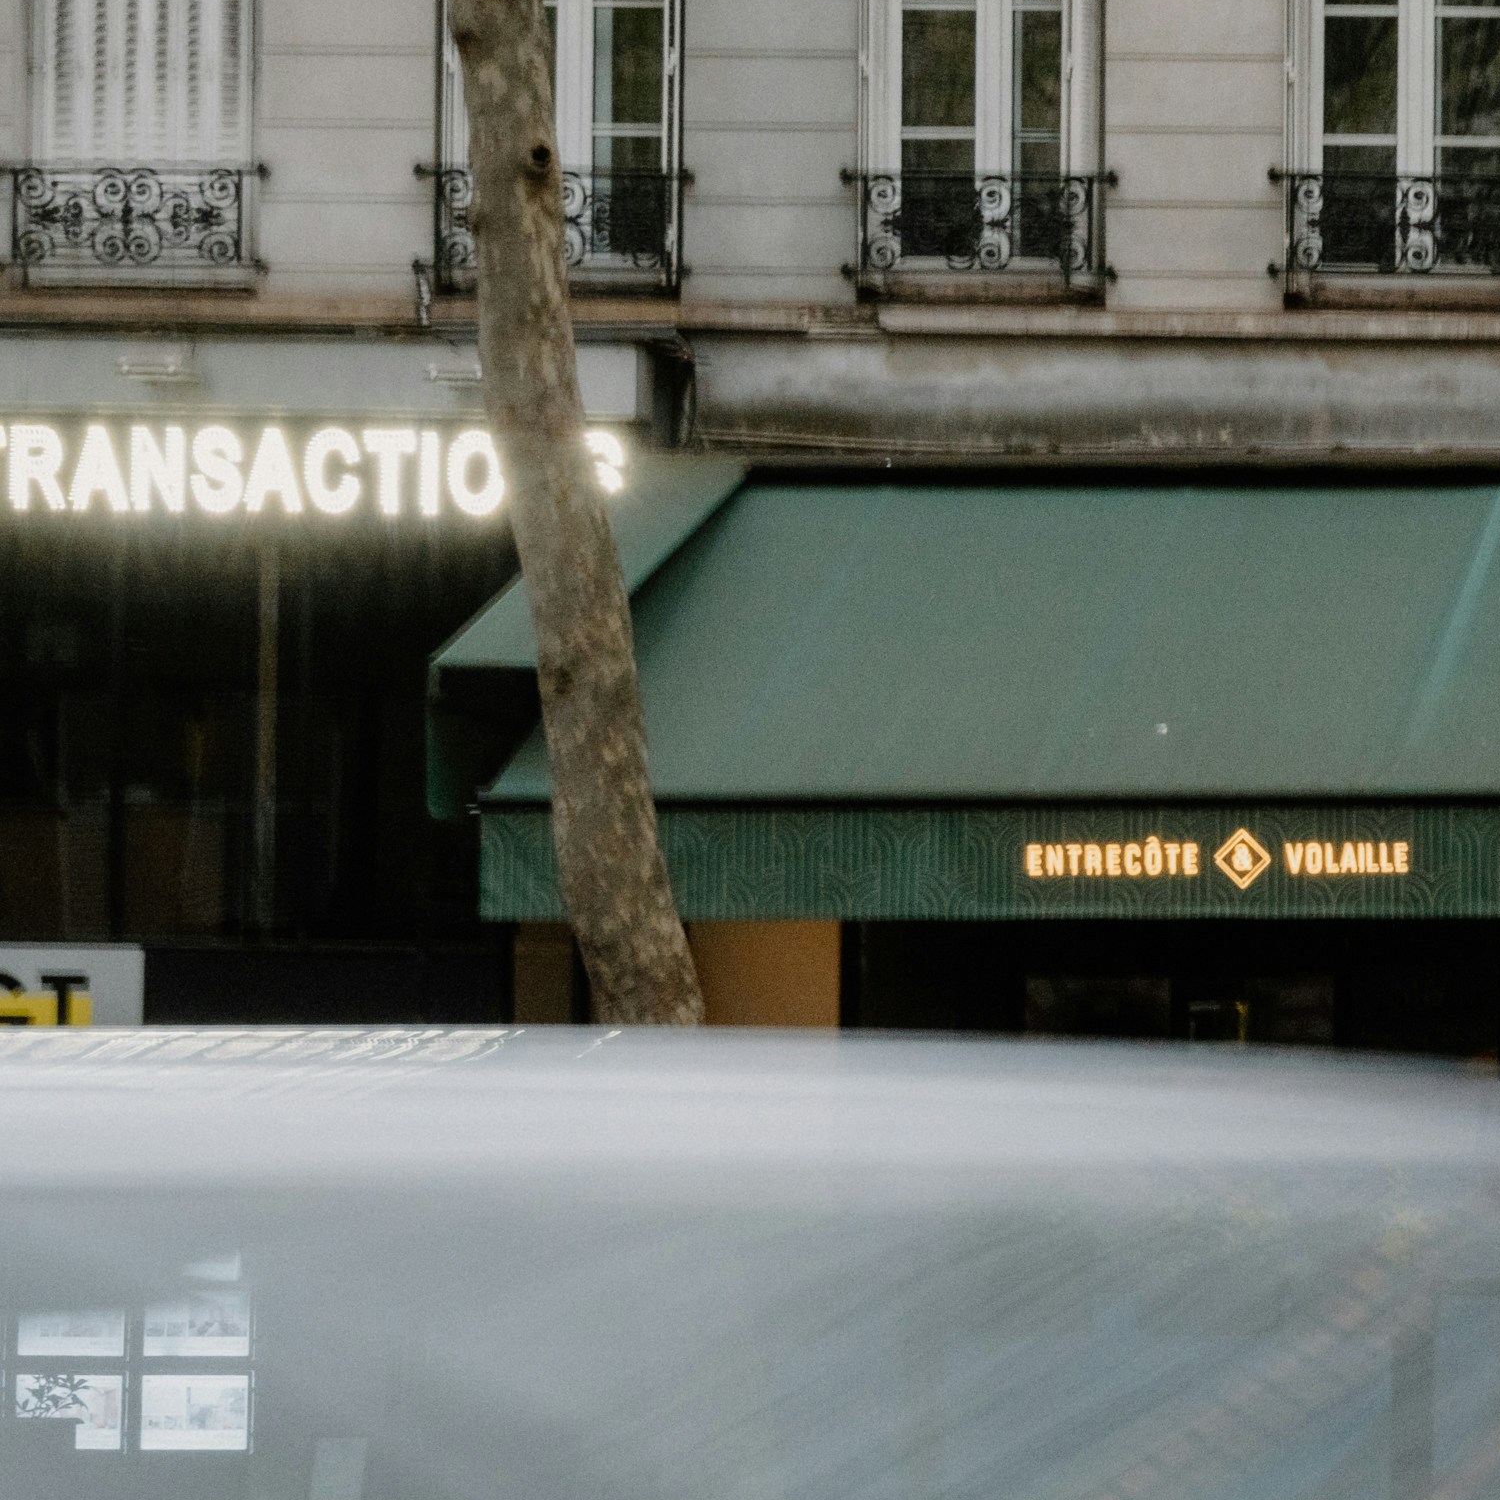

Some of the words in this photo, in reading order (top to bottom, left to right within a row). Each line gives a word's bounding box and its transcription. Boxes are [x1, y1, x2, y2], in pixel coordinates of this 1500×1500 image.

[0, 422, 626, 515] RANSACTIOS
[1026, 837, 1200, 878] ENTRECÔTE
[1231, 844, 1254, 874] &
[1285, 842, 1409, 876] VOLAILLE
